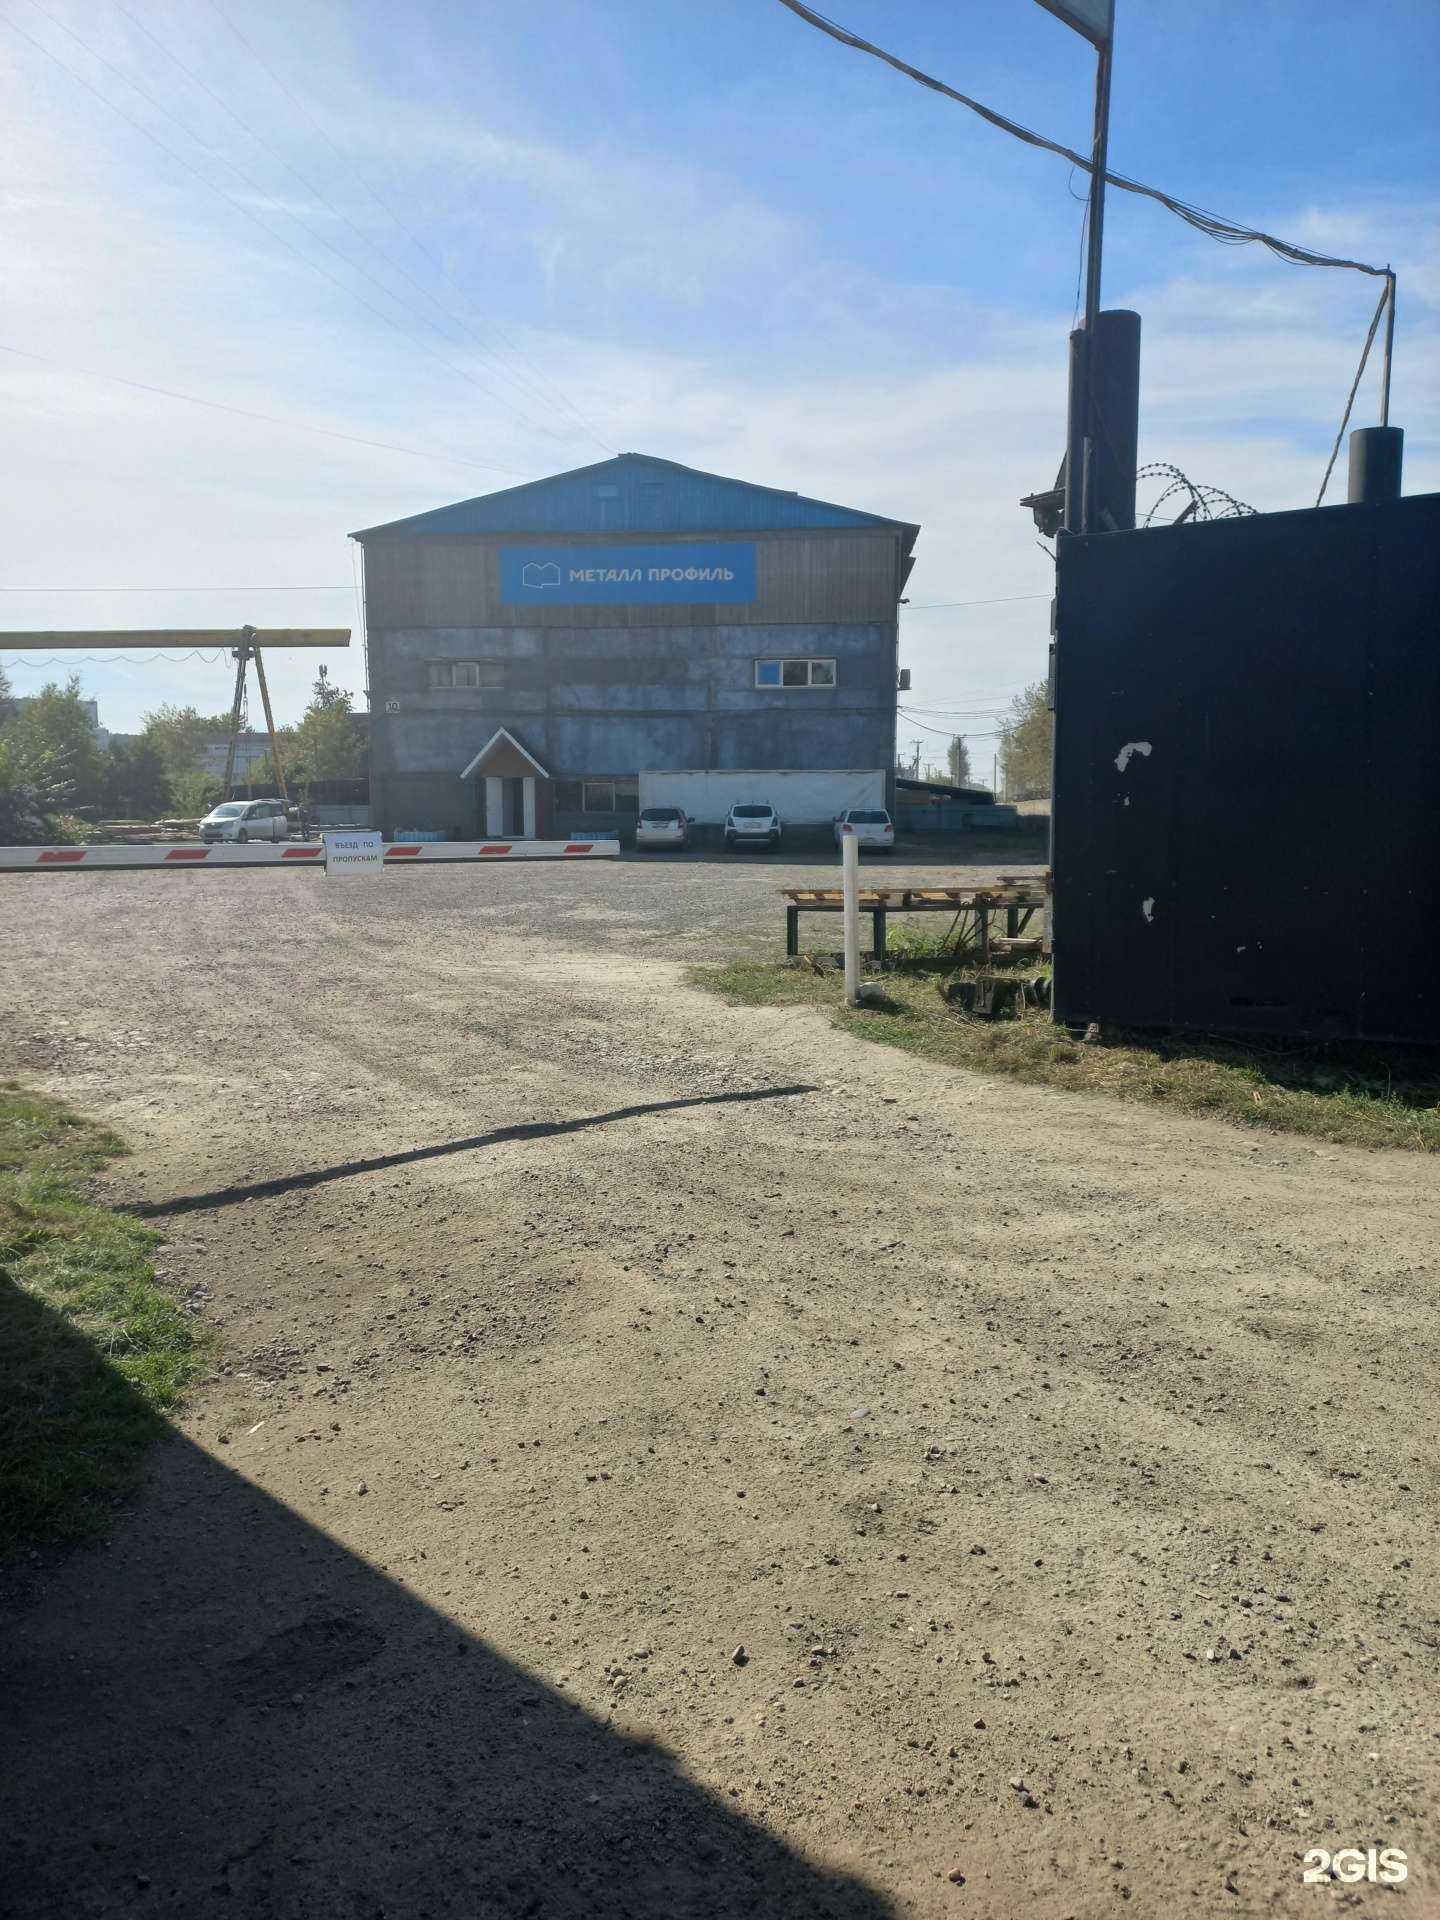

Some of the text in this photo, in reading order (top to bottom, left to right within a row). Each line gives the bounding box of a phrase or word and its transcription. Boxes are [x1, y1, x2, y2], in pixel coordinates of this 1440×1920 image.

[569, 567, 735, 582] МЕТАЛЛ ПРОФИЛЬ
[335, 841, 359, 849] ВЪЕЗД
[332, 855, 378, 863] ПРОПУСКАМ
